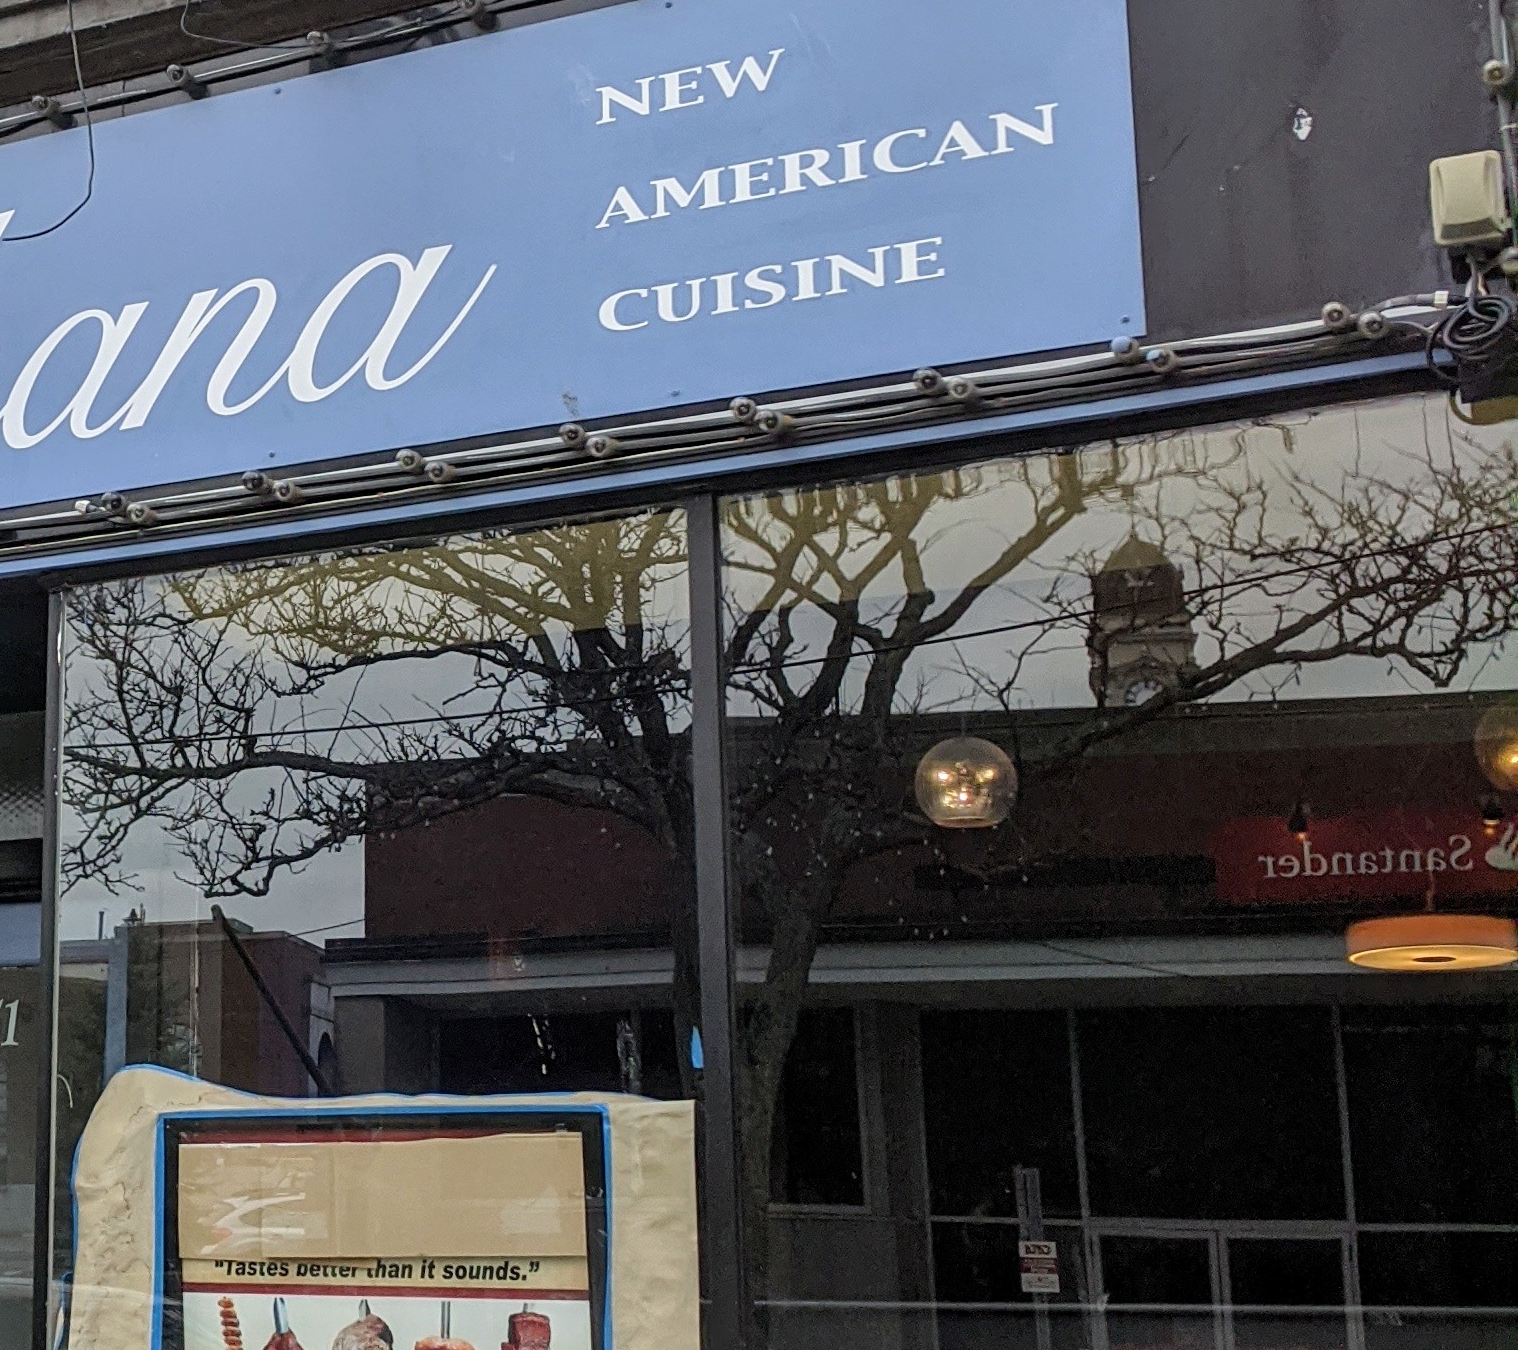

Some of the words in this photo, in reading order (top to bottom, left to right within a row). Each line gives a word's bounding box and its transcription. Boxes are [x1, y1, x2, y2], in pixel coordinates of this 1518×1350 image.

[595, 48, 785, 125] NEW
[595, 102, 1059, 229] AMERICAN
[597, 236, 946, 331] CUISINE
[420, 1259, 436, 1280] it
